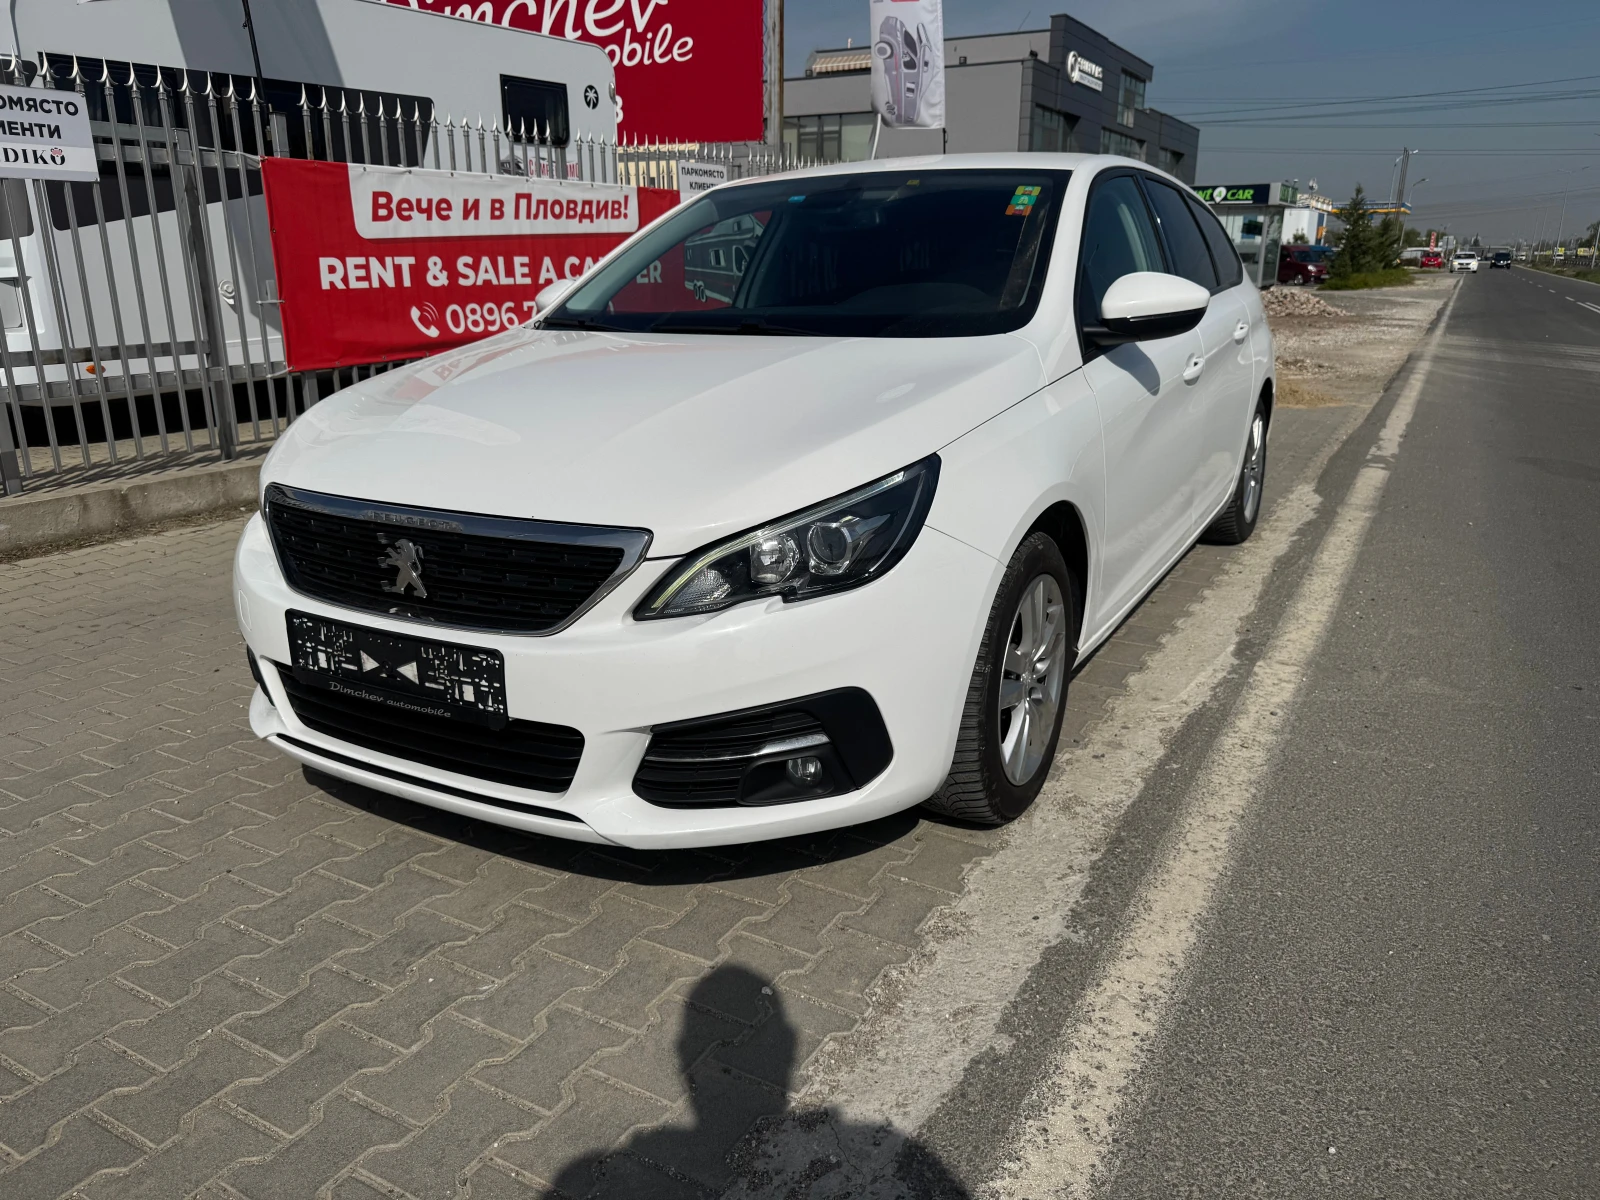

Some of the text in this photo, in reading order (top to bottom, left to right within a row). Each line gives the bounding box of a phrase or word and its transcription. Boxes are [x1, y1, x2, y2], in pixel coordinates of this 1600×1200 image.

[605, 23, 693, 67] obile
[681, 167, 725, 179] ПАРКОМЯСТО
[689, 181, 719, 191] КЛИЕНТ
[371, 191, 630, 224] Вече и в Пловдив!
[1227, 189, 1254, 200] CAR
[319, 255, 662, 291] RENT & SALE A CAER
[445, 303, 519, 335] 0896
[372, 511, 450, 530] PEUGEOT
[328, 681, 452, 718] Dimchev automobile
